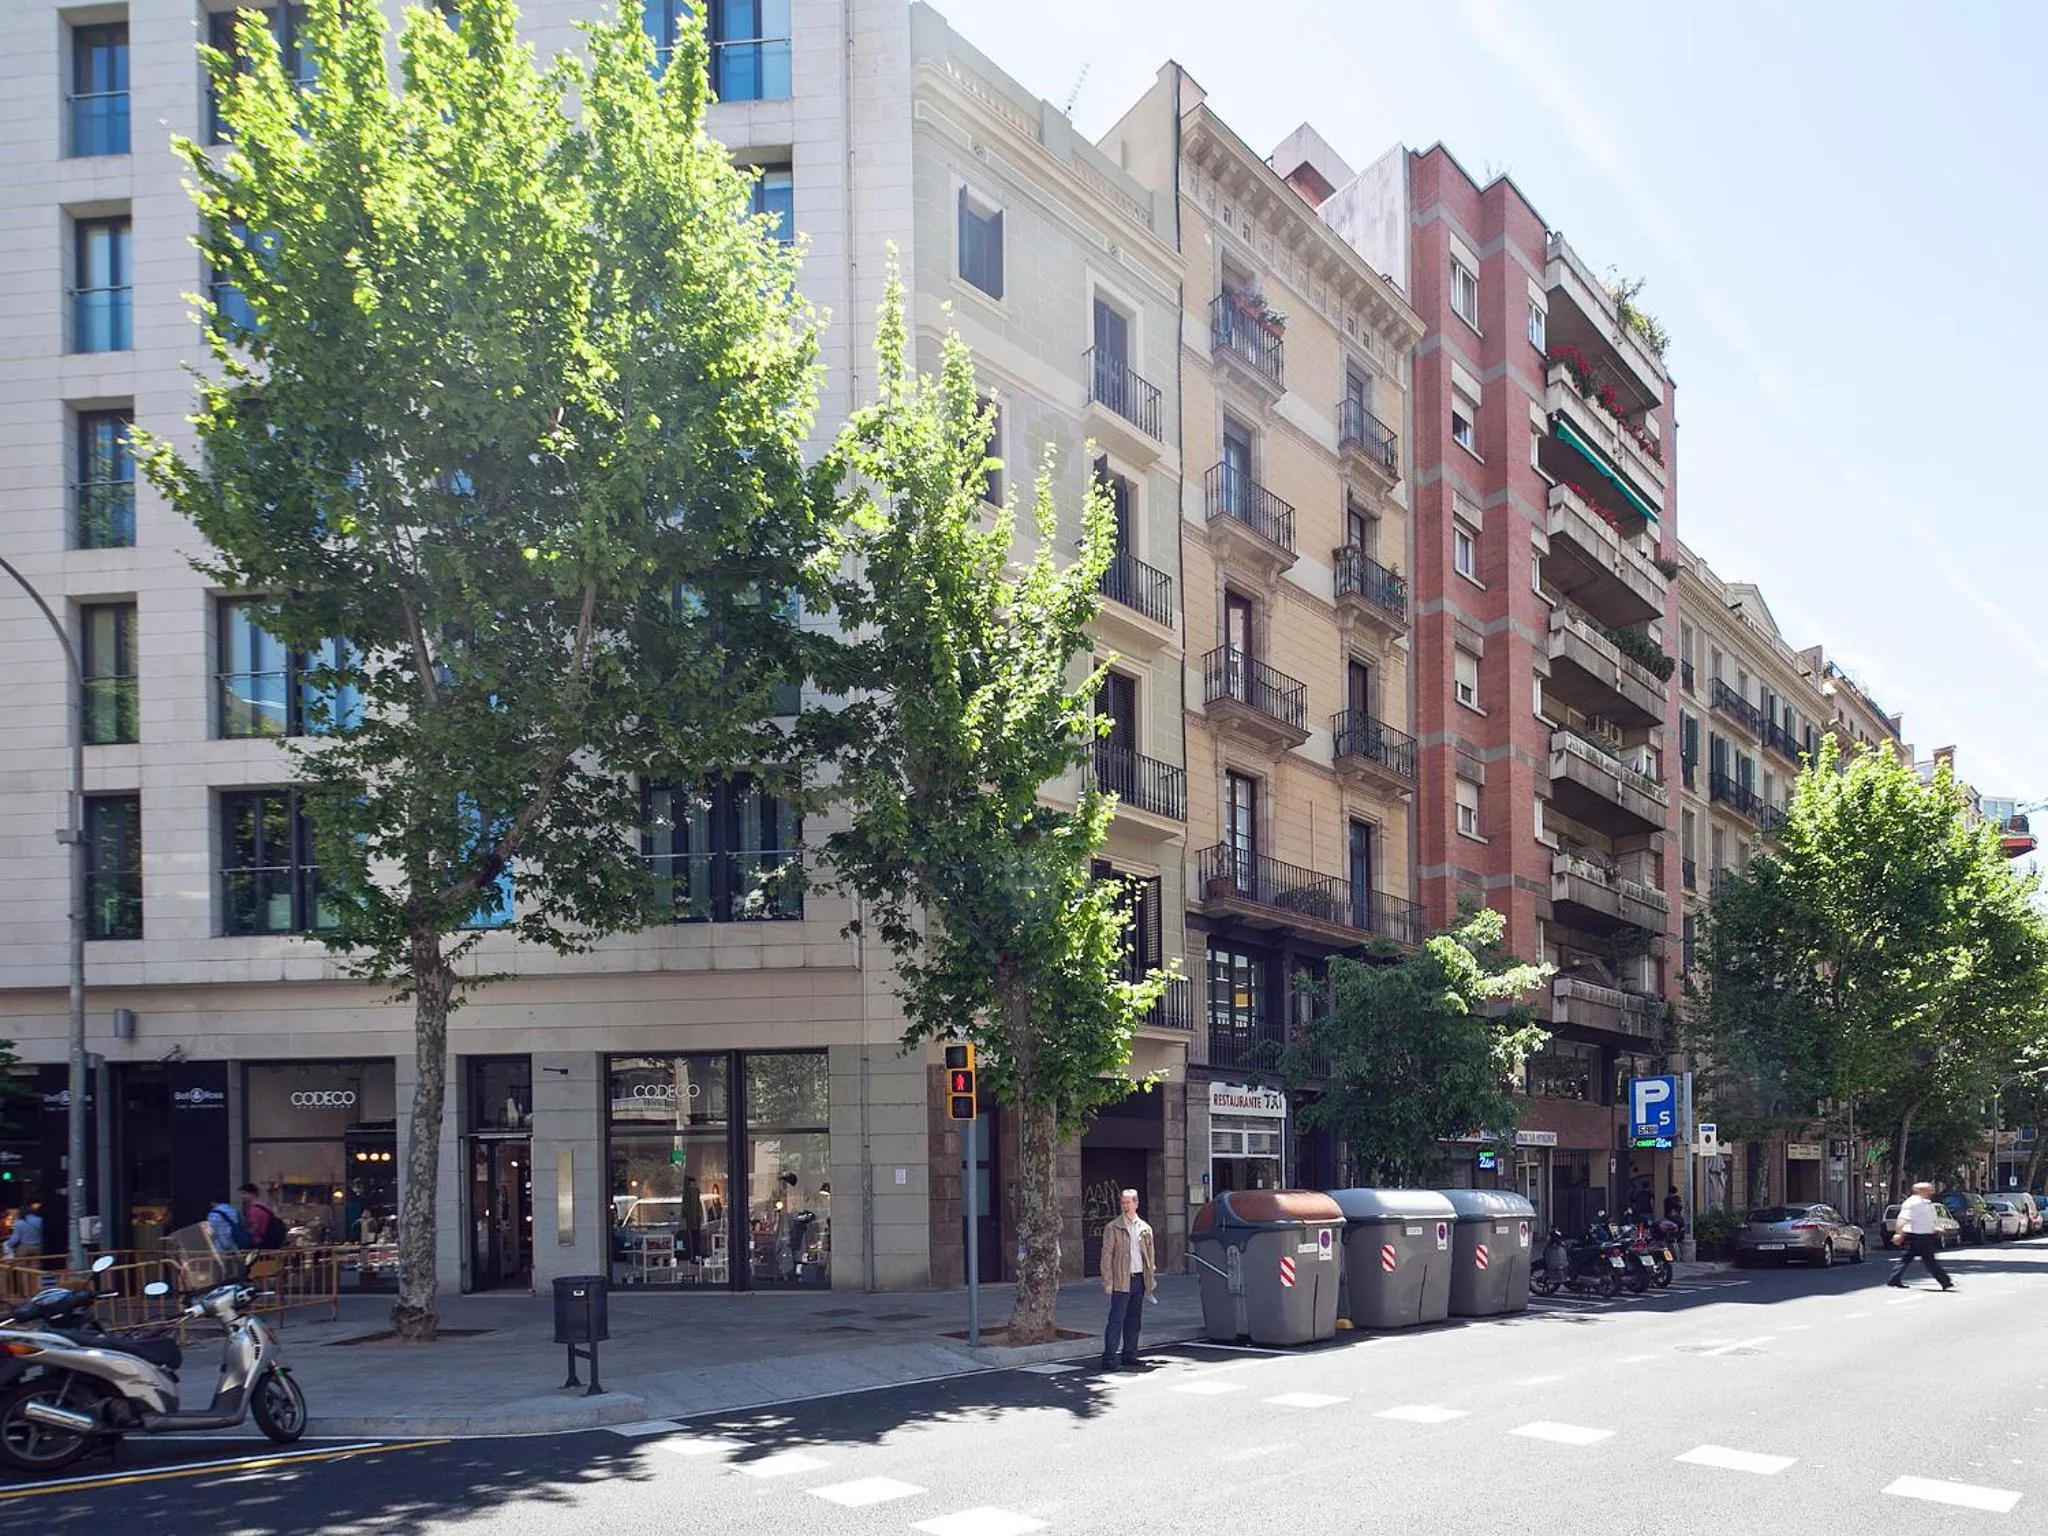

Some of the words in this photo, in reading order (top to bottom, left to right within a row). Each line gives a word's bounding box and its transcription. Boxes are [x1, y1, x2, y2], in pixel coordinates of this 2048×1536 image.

[291, 1091, 356, 1106] CODECO
[633, 1084, 700, 1098] CODECO
[1213, 1093, 1261, 1109] RESTAURANTE
[1635, 1080, 1670, 1124] P
